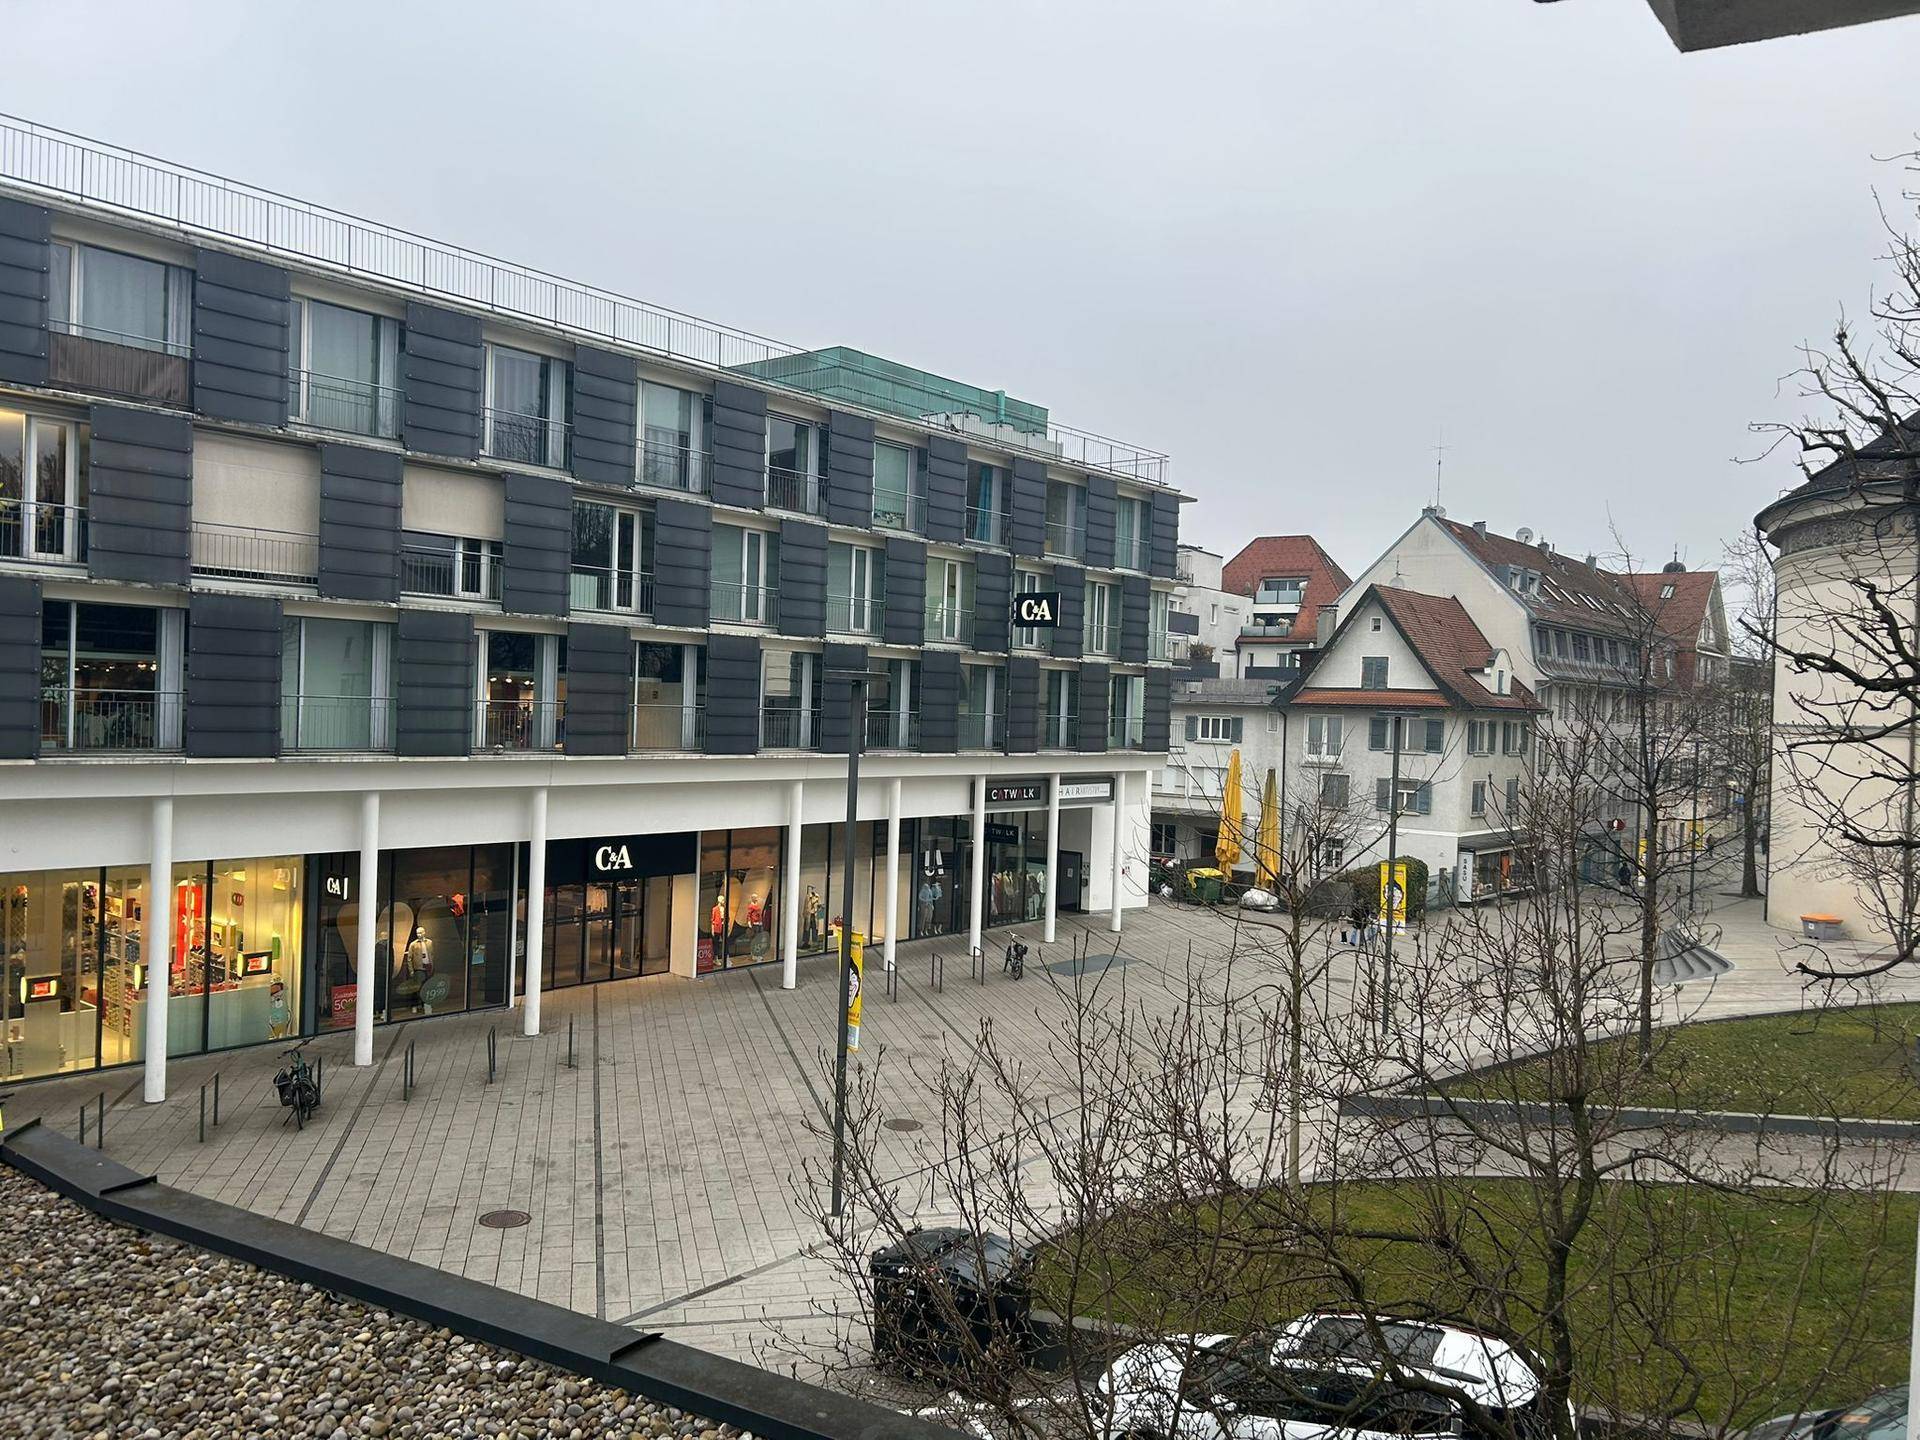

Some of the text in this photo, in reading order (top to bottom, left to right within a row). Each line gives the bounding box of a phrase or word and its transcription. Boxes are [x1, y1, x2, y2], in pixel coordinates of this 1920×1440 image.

[1021, 599, 1052, 620] C&A
[991, 788, 1035, 800] CATWALK
[595, 844, 633, 871] C&A
